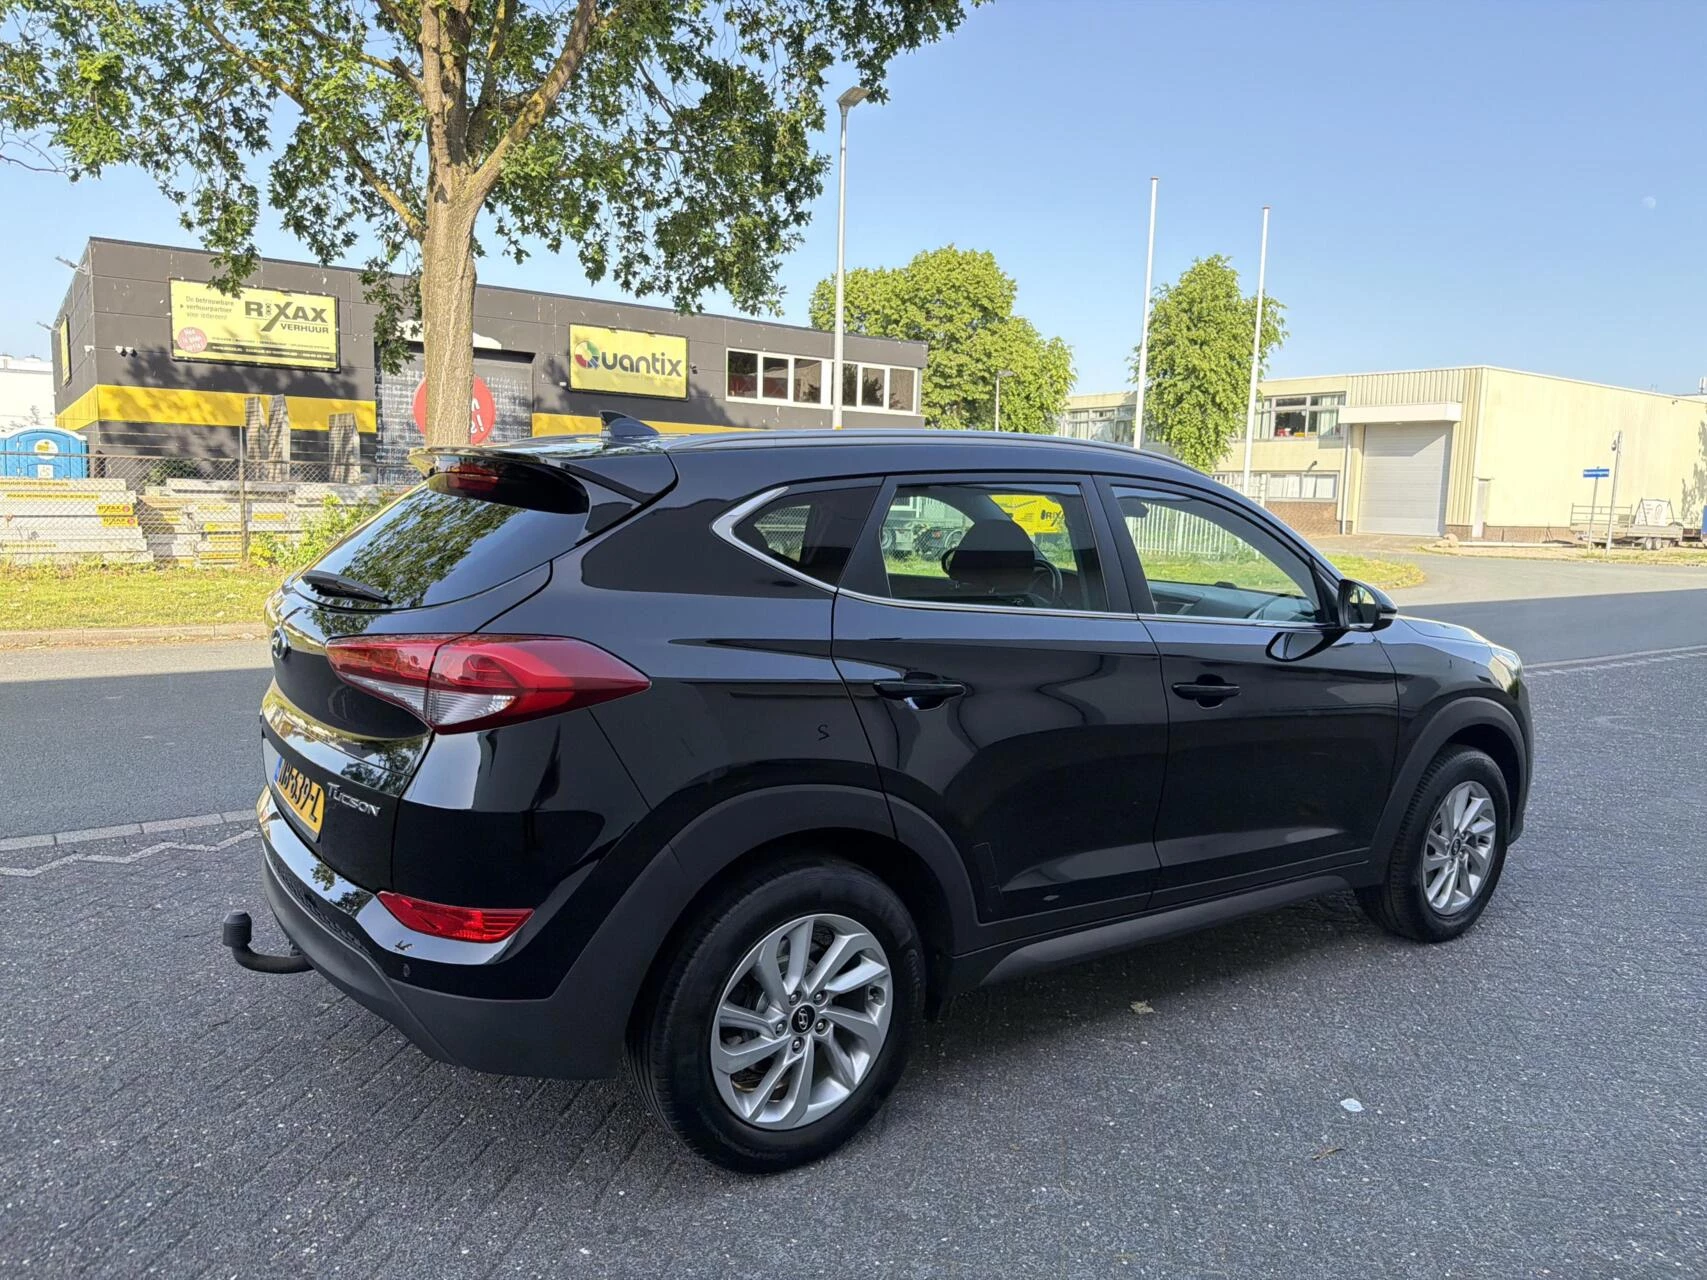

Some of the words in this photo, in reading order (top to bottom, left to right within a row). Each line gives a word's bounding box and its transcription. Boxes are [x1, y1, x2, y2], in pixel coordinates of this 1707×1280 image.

[280, 323, 329, 334] VERHUUR
[574, 340, 682, 377] Quantix
[327, 782, 380, 816] TUCSON
